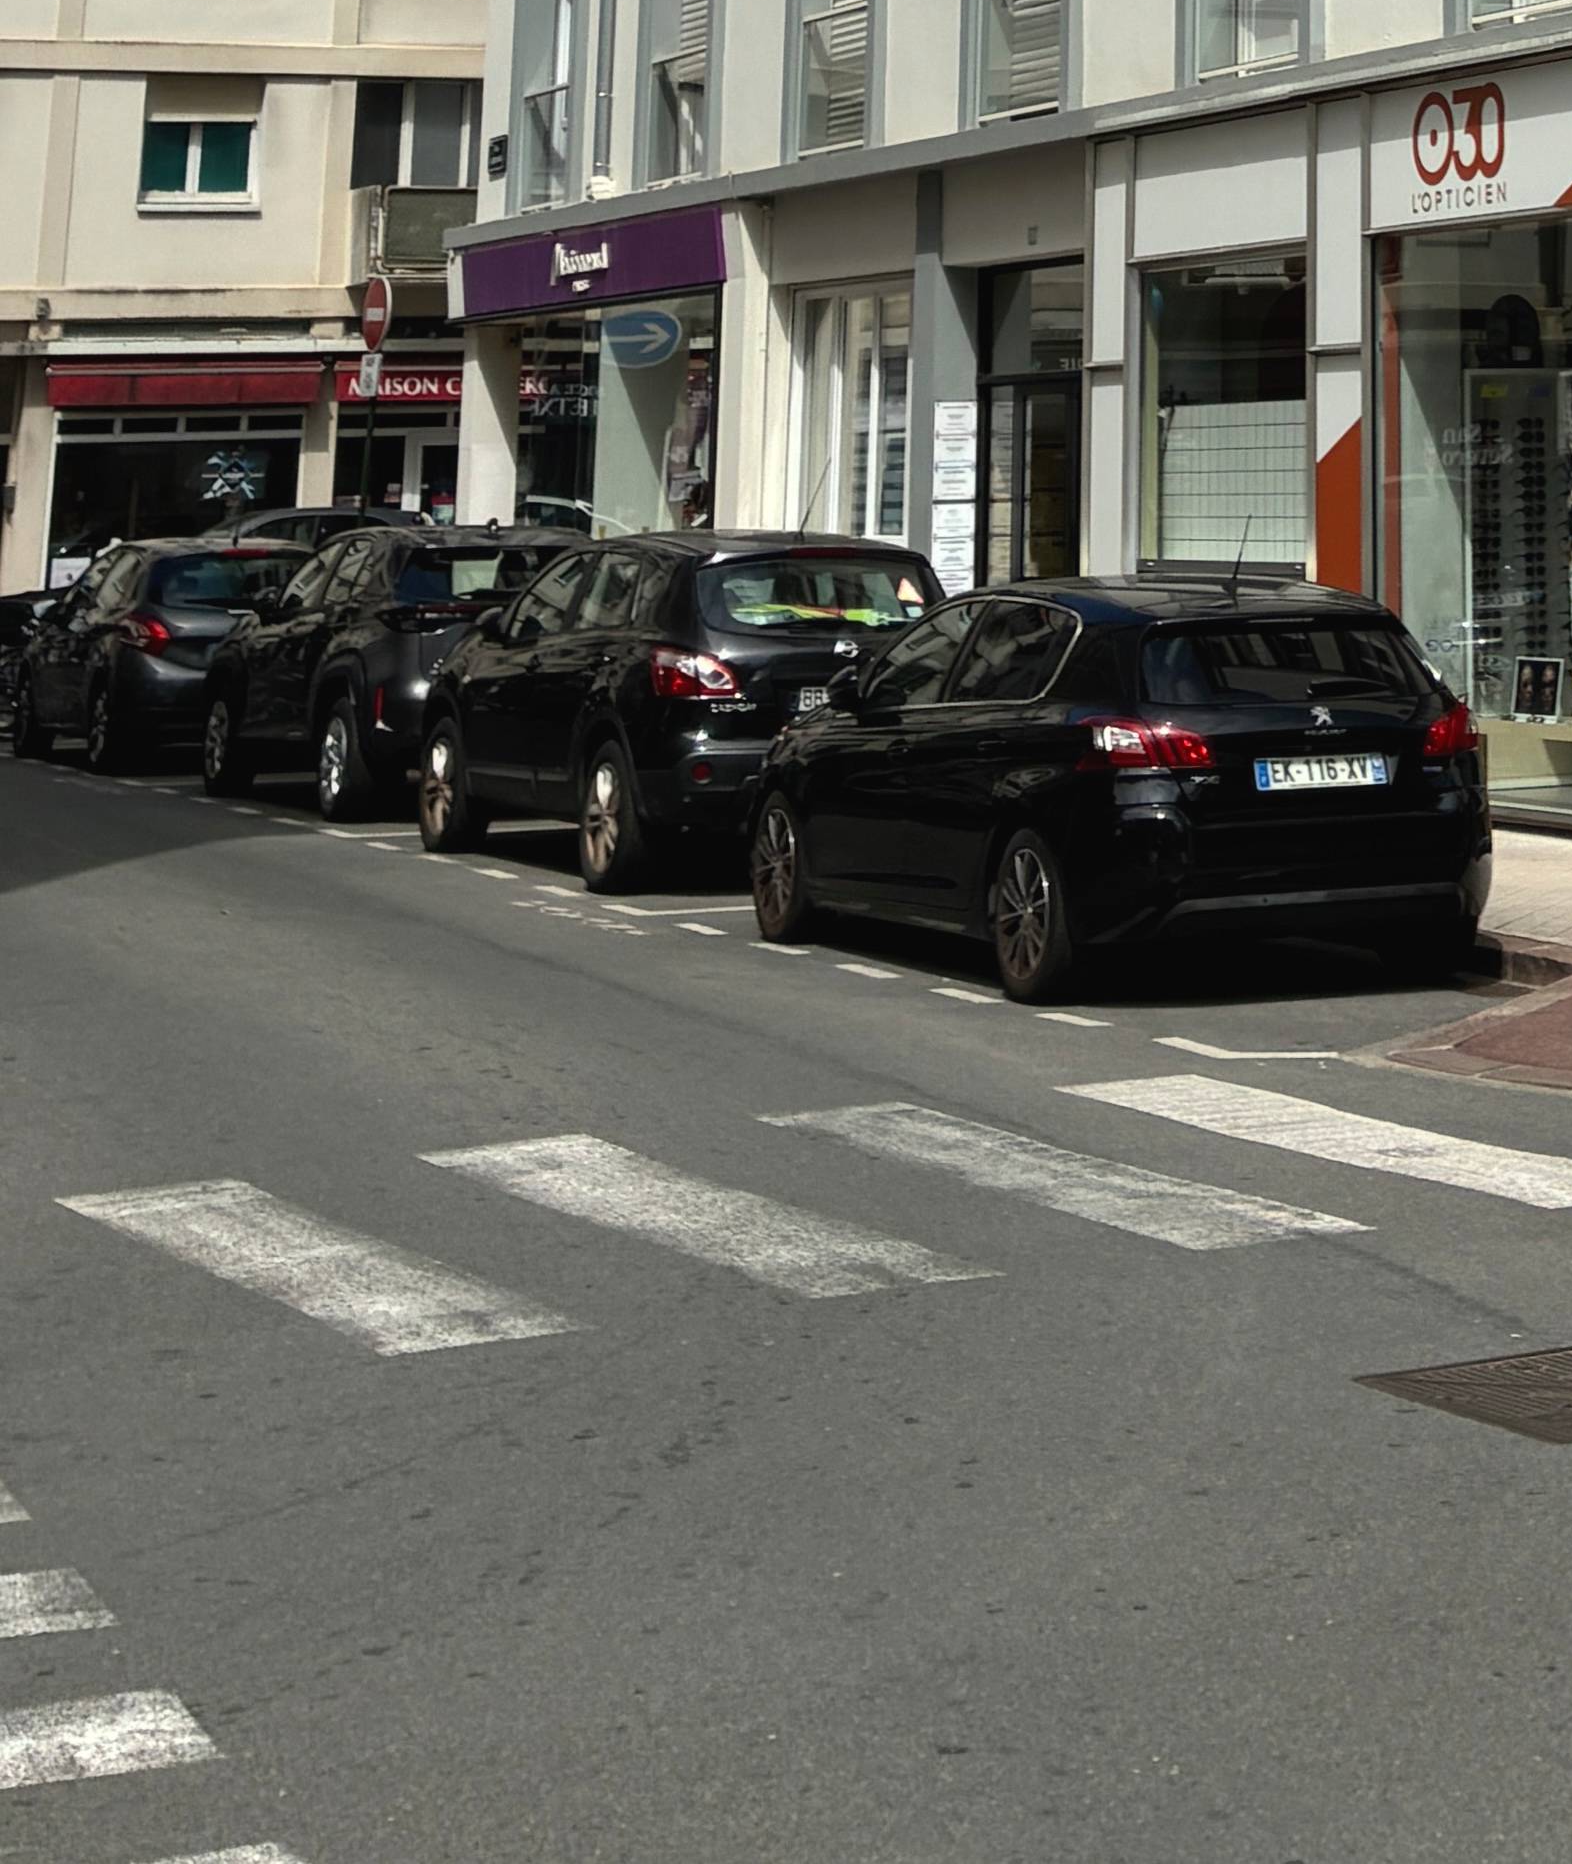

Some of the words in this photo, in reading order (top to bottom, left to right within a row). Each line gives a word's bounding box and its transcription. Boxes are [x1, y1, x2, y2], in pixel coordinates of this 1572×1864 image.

[1411, 181, 1508, 214] L'OPTICIEN
[348, 377, 438, 396] MISON
[1271, 753, 1369, 784] EK-116-XV
